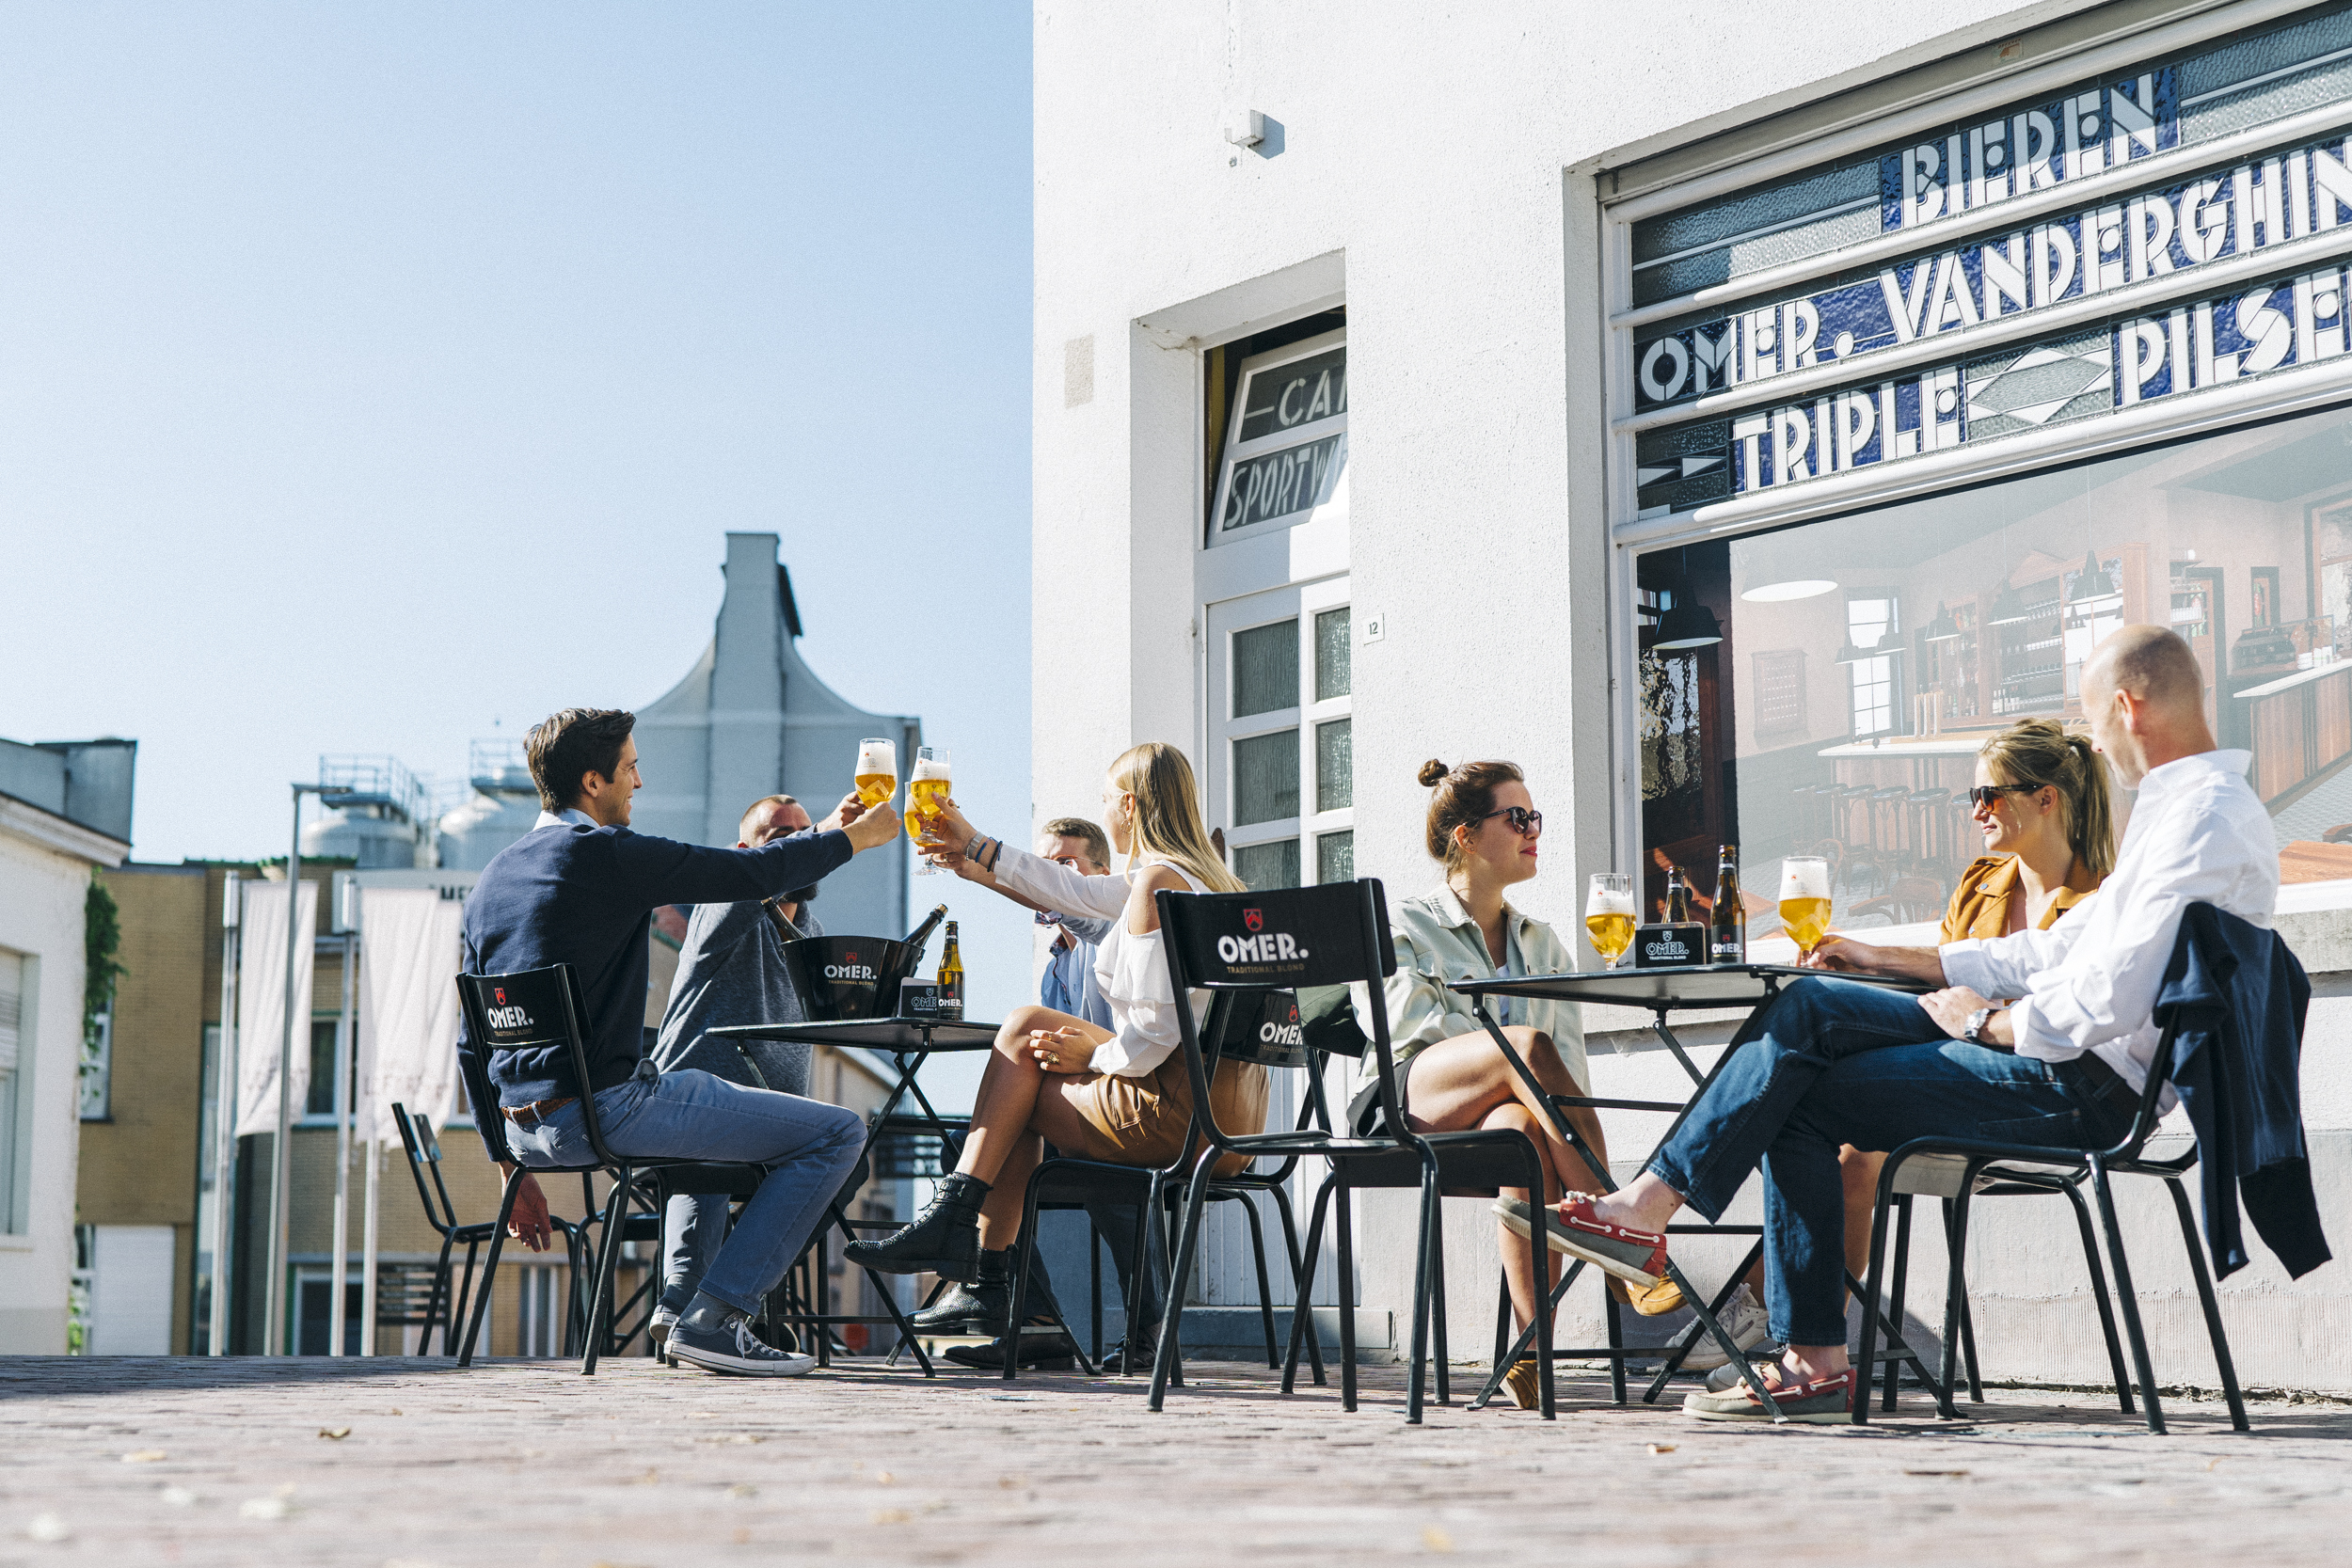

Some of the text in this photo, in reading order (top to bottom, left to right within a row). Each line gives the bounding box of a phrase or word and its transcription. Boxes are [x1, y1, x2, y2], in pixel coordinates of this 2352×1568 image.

[1901, 73, 2157, 230] BIEREN
[1639, 300, 1855, 404] OMER.
[1733, 267, 2352, 493] TRIPLE PILSE
[1369, 622, 1378, 636] 12
[1217, 932, 1310, 963] OMER.
[824, 964, 878, 979] OMER.
[1278, 963, 1305, 973] BLOND
[911, 996, 937, 1007] OME
[938, 998, 963, 1007] OMER.
[487, 1006, 534, 1029] OMER.
